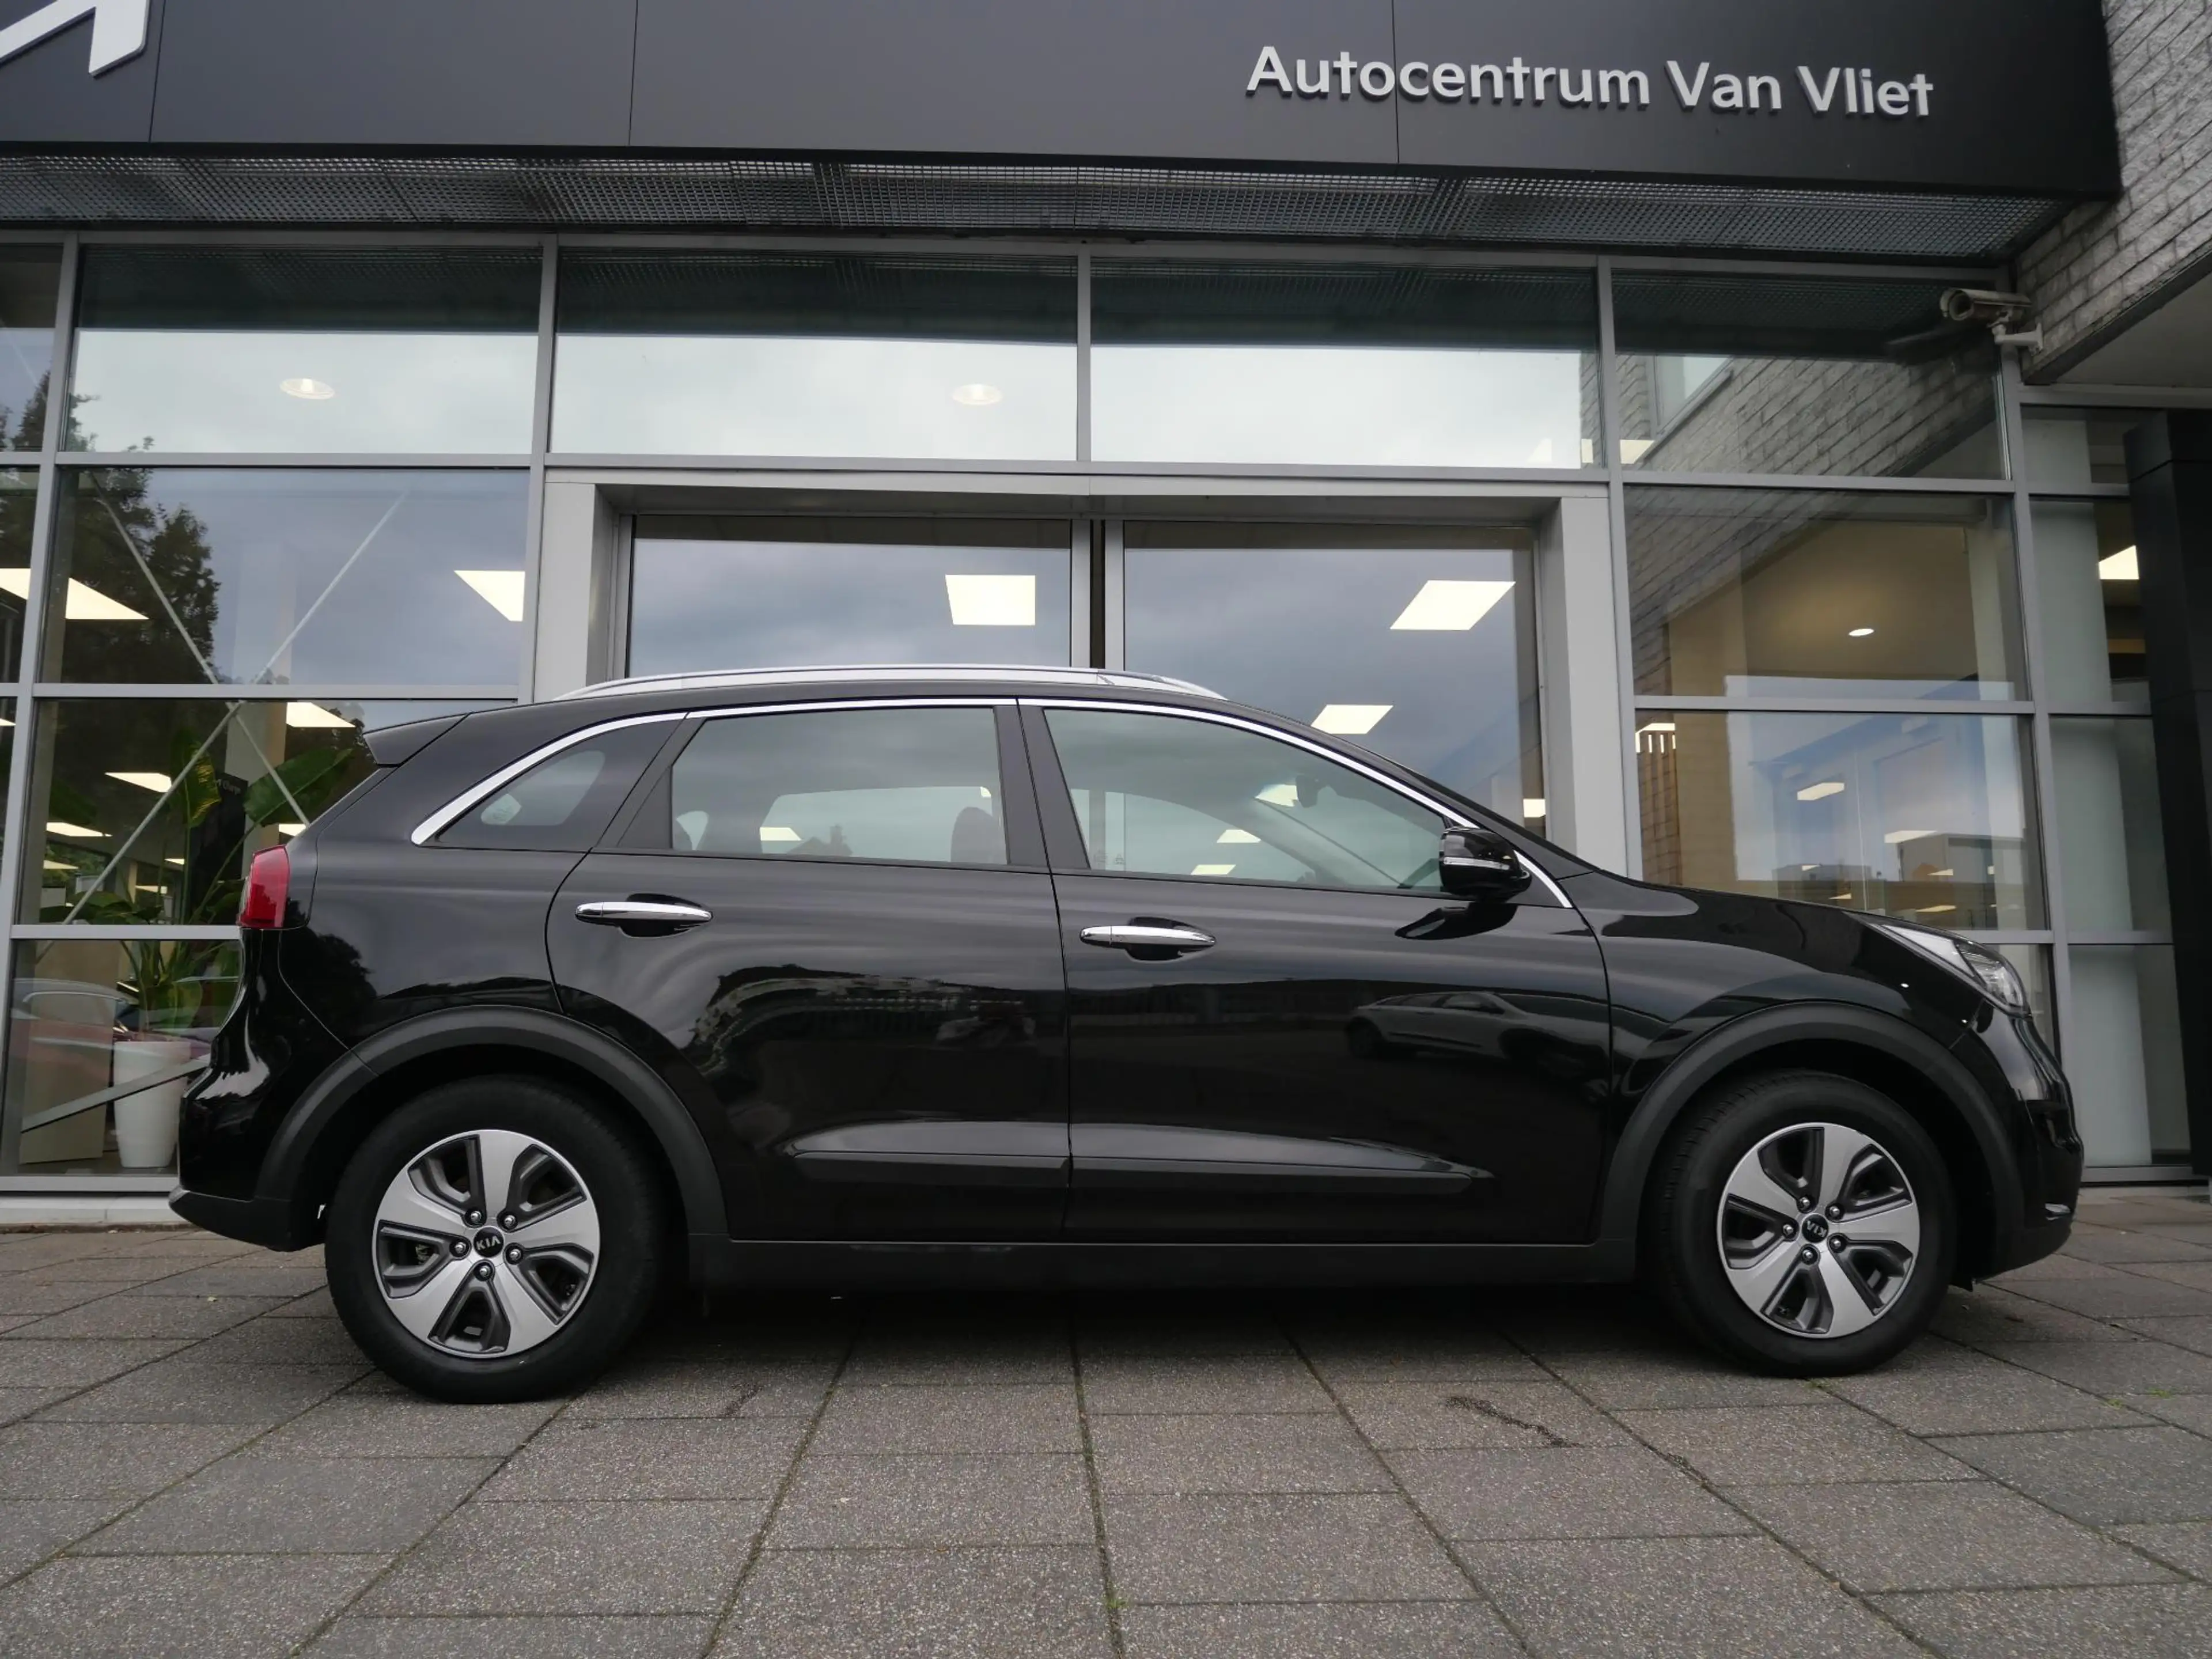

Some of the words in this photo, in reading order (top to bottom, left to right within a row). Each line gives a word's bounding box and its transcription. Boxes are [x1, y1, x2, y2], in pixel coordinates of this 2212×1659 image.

[1245, 46, 1650, 105] Autocentrum
[1665, 60, 1782, 109] Van
[1796, 65, 1934, 116] Vliet
[1806, 1220, 1827, 1238] KIA
[476, 1235, 501, 1251] KIA
